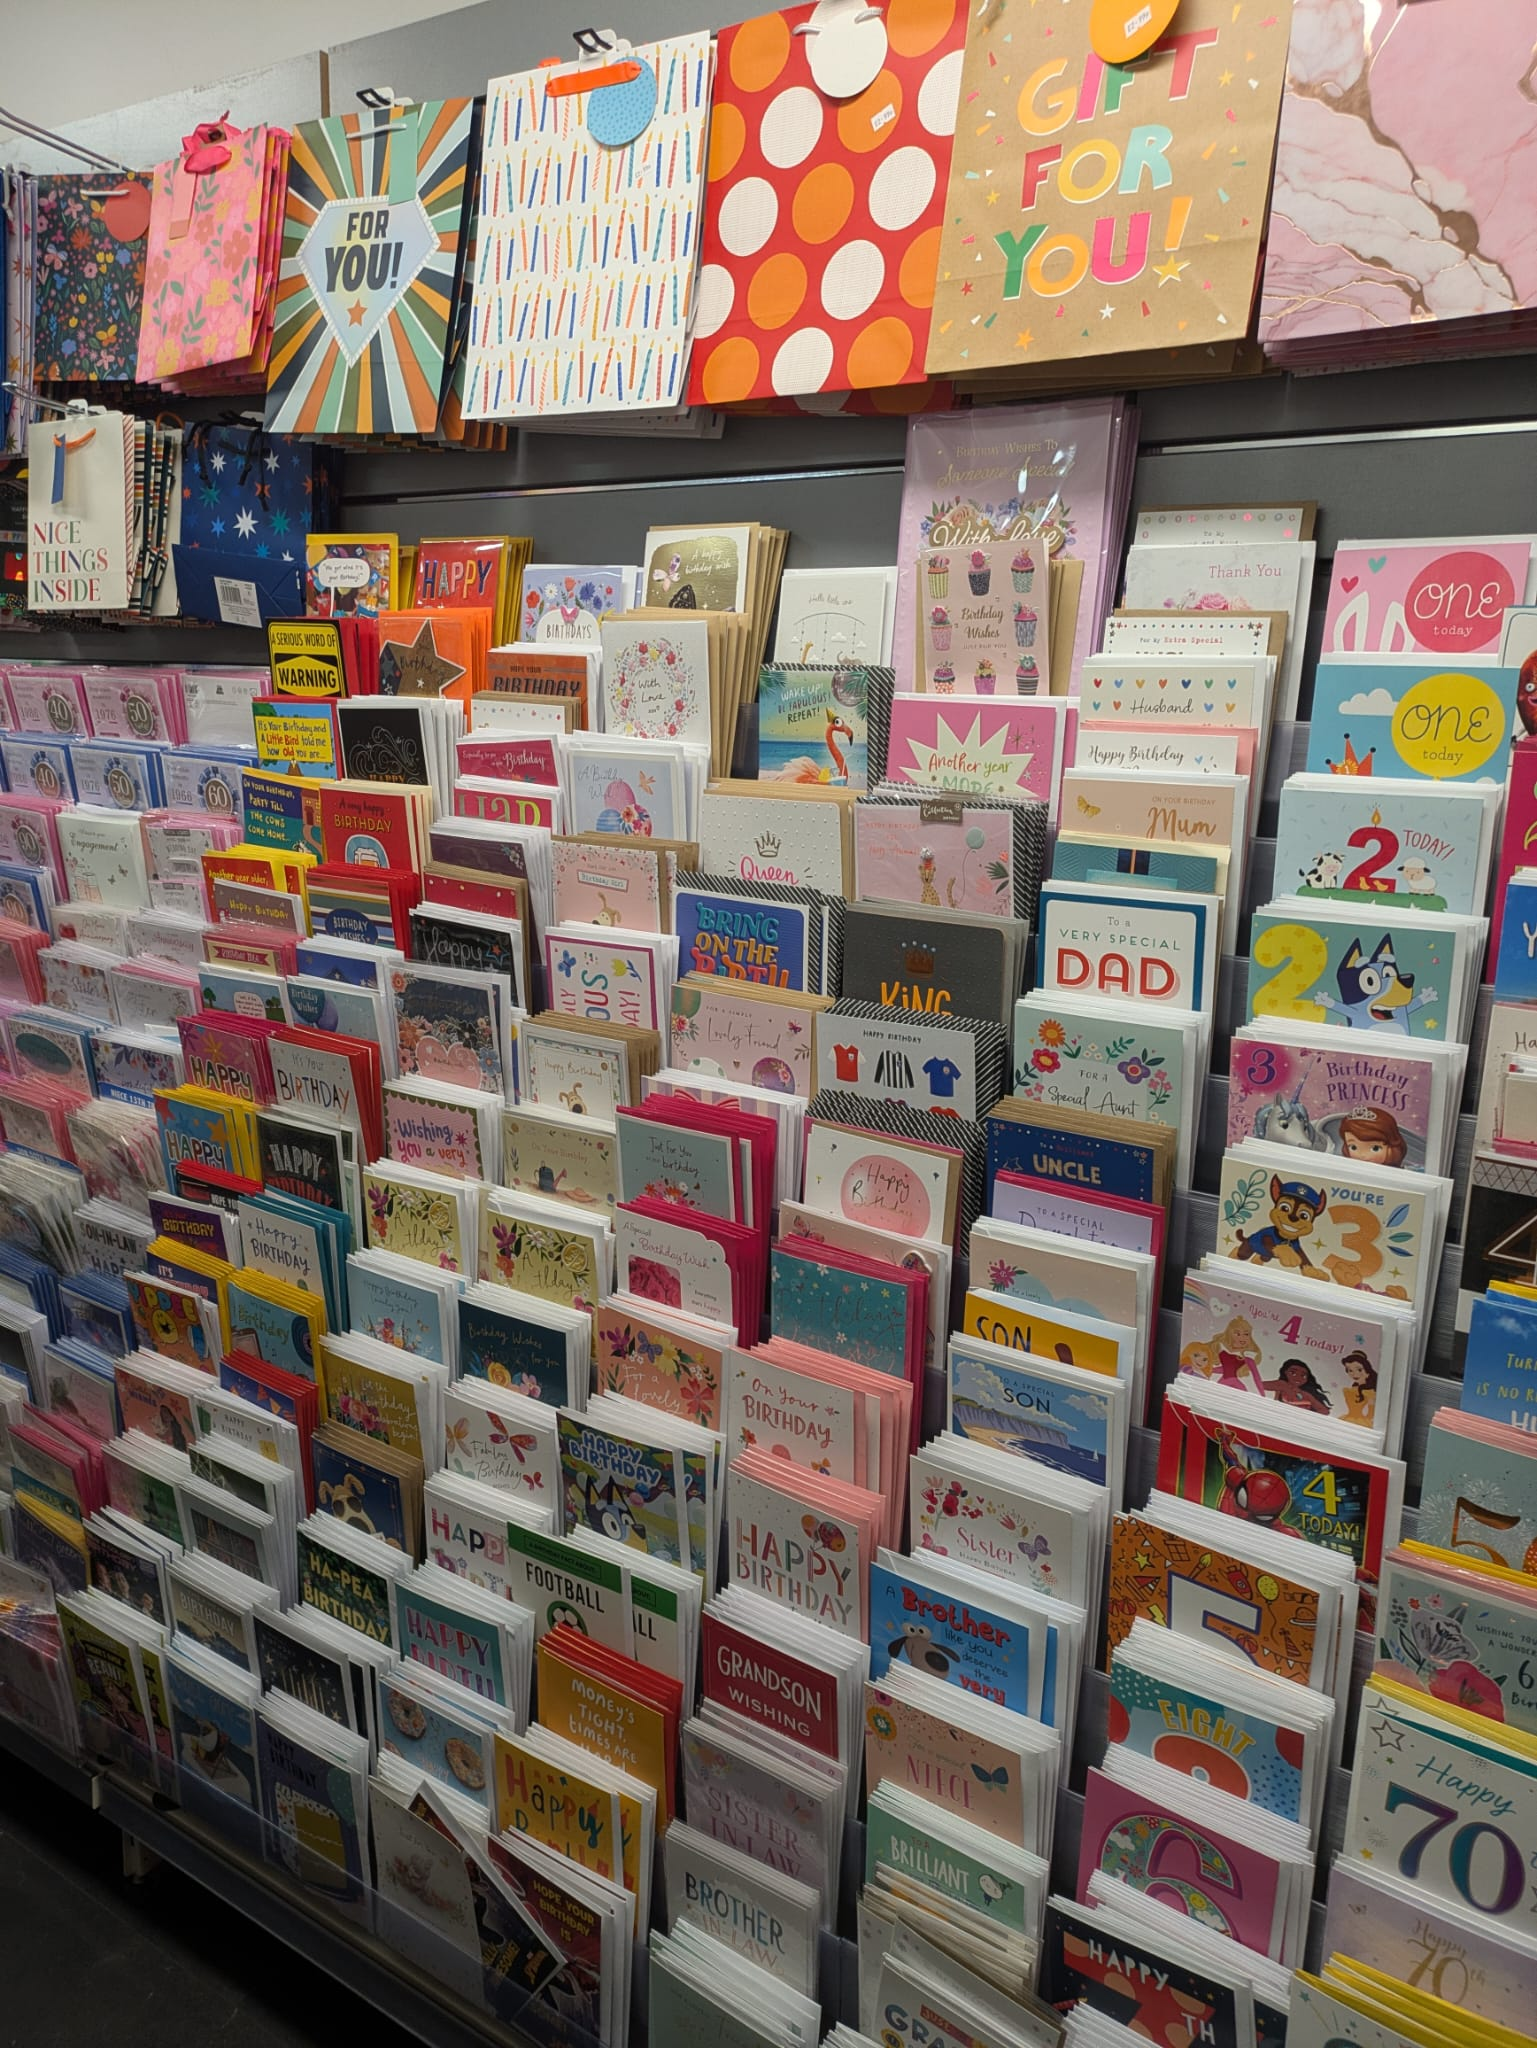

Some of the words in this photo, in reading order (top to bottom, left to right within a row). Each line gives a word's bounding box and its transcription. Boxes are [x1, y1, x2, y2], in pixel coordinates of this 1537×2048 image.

[1017, 28, 1219, 136] GIFT
[1021, 124, 1173, 211] FOR
[346, 210, 389, 240] FOR
[994, 196, 1193, 301] YOU!
[325, 242, 403, 293] YOU!
[32, 521, 82, 546] NICE
[933, 520, 992, 547] With
[33, 548, 109, 574] THINGS
[1209, 564, 1251, 578] Thank
[1257, 563, 1281, 577] You
[34, 578, 101, 603] INSIDE
[421, 560, 492, 600] HAPPY
[961, 606, 1003, 624] Birthday
[277, 632, 303, 647] SERIOUS
[304, 633, 326, 647] WORD
[327, 634, 336, 647] OF
[546, 624, 592, 639] BIRTHDAYS
[965, 624, 1000, 639] Wishes
[1433, 625, 1473, 637] today
[278, 668, 336, 689] WARNING
[493, 677, 581, 698] BIRTHDAY
[781, 687, 805, 702] WAKE
[808, 683, 823, 697] UP!
[51, 701, 68, 716] 40
[128, 701, 147, 717] 50
[788, 694, 832, 713] FABULOUS!
[788, 707, 820, 724] REPEAT!
[1130, 698, 1194, 715] Husband
[283, 721, 313, 736] Birthday
[284, 735, 299, 745] Bird
[503, 752, 546, 773] Birthday
[928, 753, 982, 774] Another
[983, 760, 1013, 777] year
[1089, 745, 1125, 763] Happy
[1129, 745, 1184, 766] Birthday
[1423, 747, 1464, 765] today
[38, 769, 55, 788] 40
[112, 774, 130, 796] 50
[209, 786, 227, 806] 60
[334, 815, 392, 833] BIRTHDAY
[1146, 807, 1217, 839] Mum
[71, 837, 118, 852] Engagement
[740, 856, 799, 885] Queen
[1343, 826, 1399, 893] 2
[1404, 829, 1456, 861] TODAY!
[333, 917, 368, 932] BIRTHDAY
[696, 902, 779, 943] BRING
[1107, 915, 1120, 927] To
[423, 927, 482, 968] Happy
[695, 933, 729, 956] ON
[734, 938, 779, 966] THE
[1060, 928, 1100, 943] VERY
[1110, 934, 1181, 951] SPECIAL
[1057, 948, 1180, 999] DAD
[1253, 924, 1328, 1024] 2
[707, 1017, 742, 1046] Lovely
[863, 1029, 884, 1041] HAPPY
[887, 1032, 922, 1045] BIRTHDAY
[190, 1055, 254, 1101] HAPPY
[544, 1056, 564, 1080] Happy
[568, 1062, 603, 1085] Birthday
[1247, 1048, 1277, 1085] 3
[1326, 1061, 1411, 1090] Birthday
[277, 1069, 349, 1115] BIRTHDAY
[1048, 1085, 1090, 1112] Special
[1093, 1091, 1140, 1118] Aunt
[1326, 1082, 1411, 1112] PRINCESS
[398, 1119, 453, 1145] Wishing
[165, 1129, 227, 1169] HAPPY
[269, 1143, 323, 1182] HAPPY
[398, 1139, 421, 1164] you
[438, 1146, 466, 1168] very
[649, 1137, 664, 1153] Just
[679, 1145, 693, 1159] You
[662, 1159, 699, 1177] birthday
[1033, 1153, 1102, 1185] UNCLE
[867, 1163, 910, 1203] Happy
[1330, 1186, 1385, 1207] YOU'RE
[161, 1218, 215, 1238] BIRTHDAY
[256, 1217, 298, 1250] Happy
[1060, 1212, 1104, 1231] SPECIAL
[639, 1238, 683, 1264] Birthday
[685, 1254, 709, 1271] Wish
[1321, 1204, 1384, 1278] 3
[158, 1265, 174, 1278] IT'S
[251, 1239, 311, 1275] BIRTHDAY
[1249, 1304, 1280, 1322] You're
[468, 1322, 509, 1343] Birthday
[513, 1331, 543, 1349] Wishes
[976, 1316, 1032, 1353] SON
[1278, 1315, 1303, 1345] 4
[1305, 1335, 1345, 1354] Today!
[623, 1364, 645, 1385] For
[634, 1385, 682, 1414] lovely
[752, 1377, 774, 1397] On
[779, 1384, 819, 1412] Your
[1003, 1387, 1051, 1414] SON
[1022, 1382, 1055, 1398] SPECIAL
[1498, 1386, 1519, 1400] NO
[224, 1413, 245, 1428] HAPPY
[366, 1396, 415, 1418] birthday
[742, 1394, 833, 1448] BIRTHDAY
[221, 1425, 253, 1442] BIRTHDAY
[582, 1430, 643, 1464] HAPPY
[475, 1461, 524, 1488] Birthday
[569, 1439, 662, 1486] BIRTHDAY
[1303, 1471, 1342, 1517] 4
[1300, 1512, 1360, 1543] TODAY!
[736, 1517, 852, 1596] HAPPY
[957, 1526, 1015, 1565] Sister
[310, 1552, 373, 1605] HA-PEA
[526, 1561, 605, 1614] FOOTBALL
[736, 1552, 853, 1626] BIRTHDAY
[181, 1591, 235, 1633] BIRTHDAY
[303, 1584, 390, 1644] BIRTHDAY
[901, 1586, 1011, 1648] Brother
[406, 1606, 490, 1666] HAPPY
[944, 1631, 964, 1645] like
[968, 1641, 993, 1659] you
[1475, 1624, 1514, 1639] WISHING
[962, 1654, 1009, 1678] deserves
[974, 1668, 991, 1681] the
[717, 1646, 822, 1721] GRANDSON
[959, 1674, 1007, 1706] very
[728, 1686, 811, 1737] WISHING
[1157, 1699, 1256, 1756] EIGHT
[614, 1745, 637, 1764] ARE
[1416, 1755, 1517, 1816] Happy
[504, 1753, 604, 1849] Happy
[707, 1786, 800, 1857] SISTER
[1384, 1780, 1526, 1916] 70
[890, 1834, 969, 1896] BRILLIANT
[533, 1880, 561, 1901] HOPE
[566, 1901, 595, 1926] YOUR
[540, 1899, 590, 1936] BIRTHDAY
[685, 1871, 785, 1955] BROTHER
[1412, 1918, 1467, 1957] Happy
[1089, 1938, 1169, 1991] HAPPY
